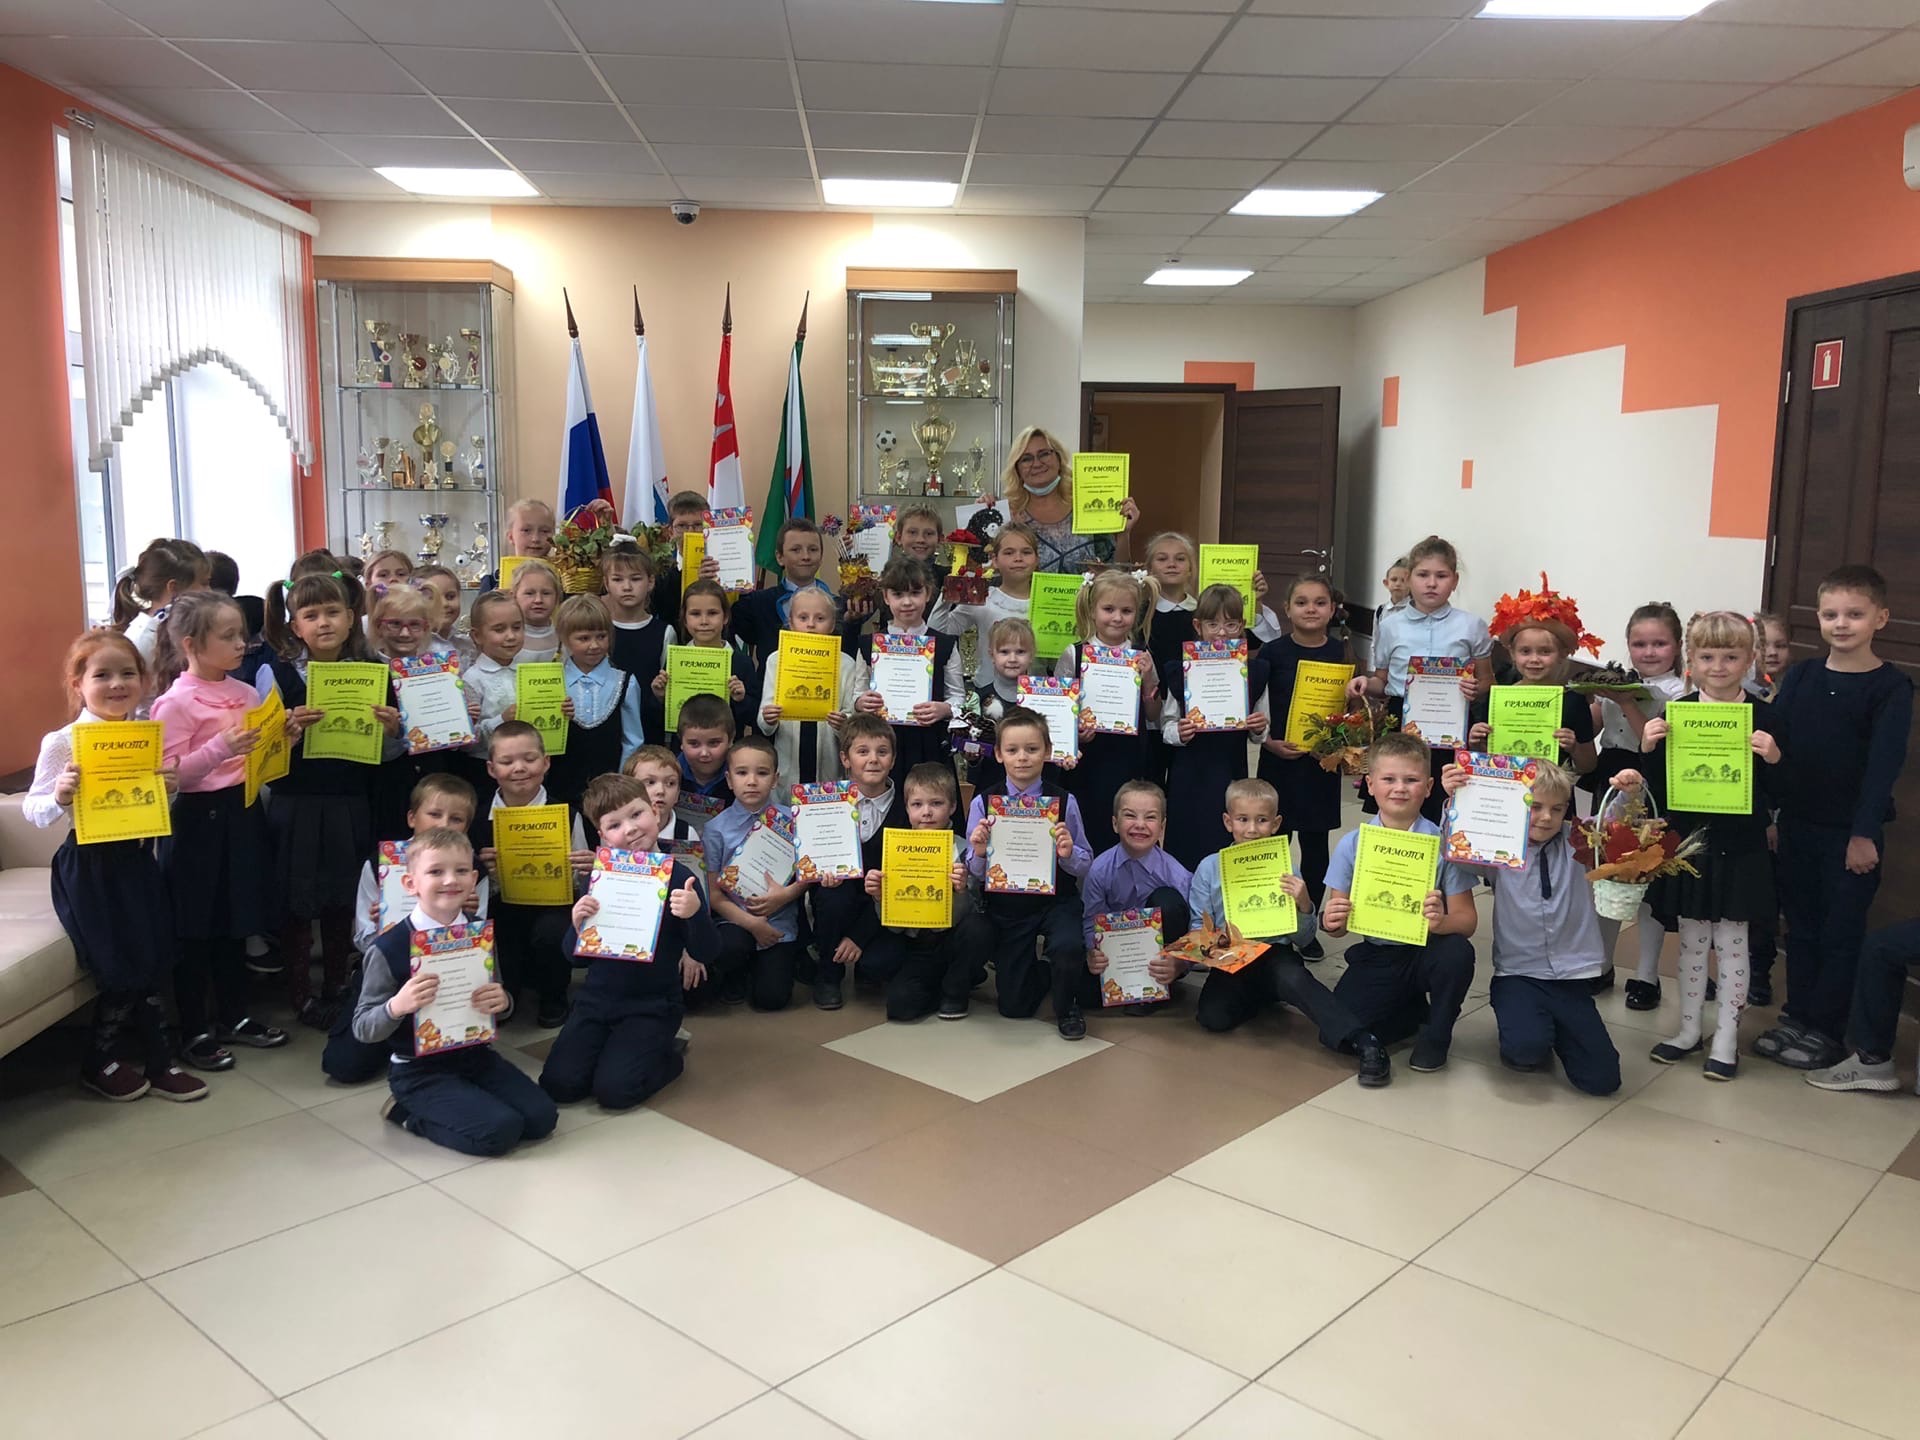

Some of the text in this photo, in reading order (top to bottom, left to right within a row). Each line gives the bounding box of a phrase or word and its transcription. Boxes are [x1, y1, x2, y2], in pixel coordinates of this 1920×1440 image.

[1043, 586, 1078, 595] ГРАМОТ
[790, 647, 830, 657] ГРАМОТА
[680, 660, 720, 669] ГРАМОТА
[324, 678, 375, 686] ГРАМОТА
[1305, 675, 1345, 687] ГРАМОТА
[1683, 719, 1738, 729] ГРАМОТА
[93, 740, 149, 751] ГРАМОТА
[1473, 767, 1514, 778] ГРАМОТА
[1005, 807, 1040, 816] ГРАМОТА
[509, 821, 557, 831] ГРАМОТА
[896, 845, 941, 854] ГРАМОТА
[1374, 844, 1425, 860] ГРАМОТА
[1233, 851, 1278, 864] ГРАМОТА
[613, 863, 651, 874] ГРАМОТА
